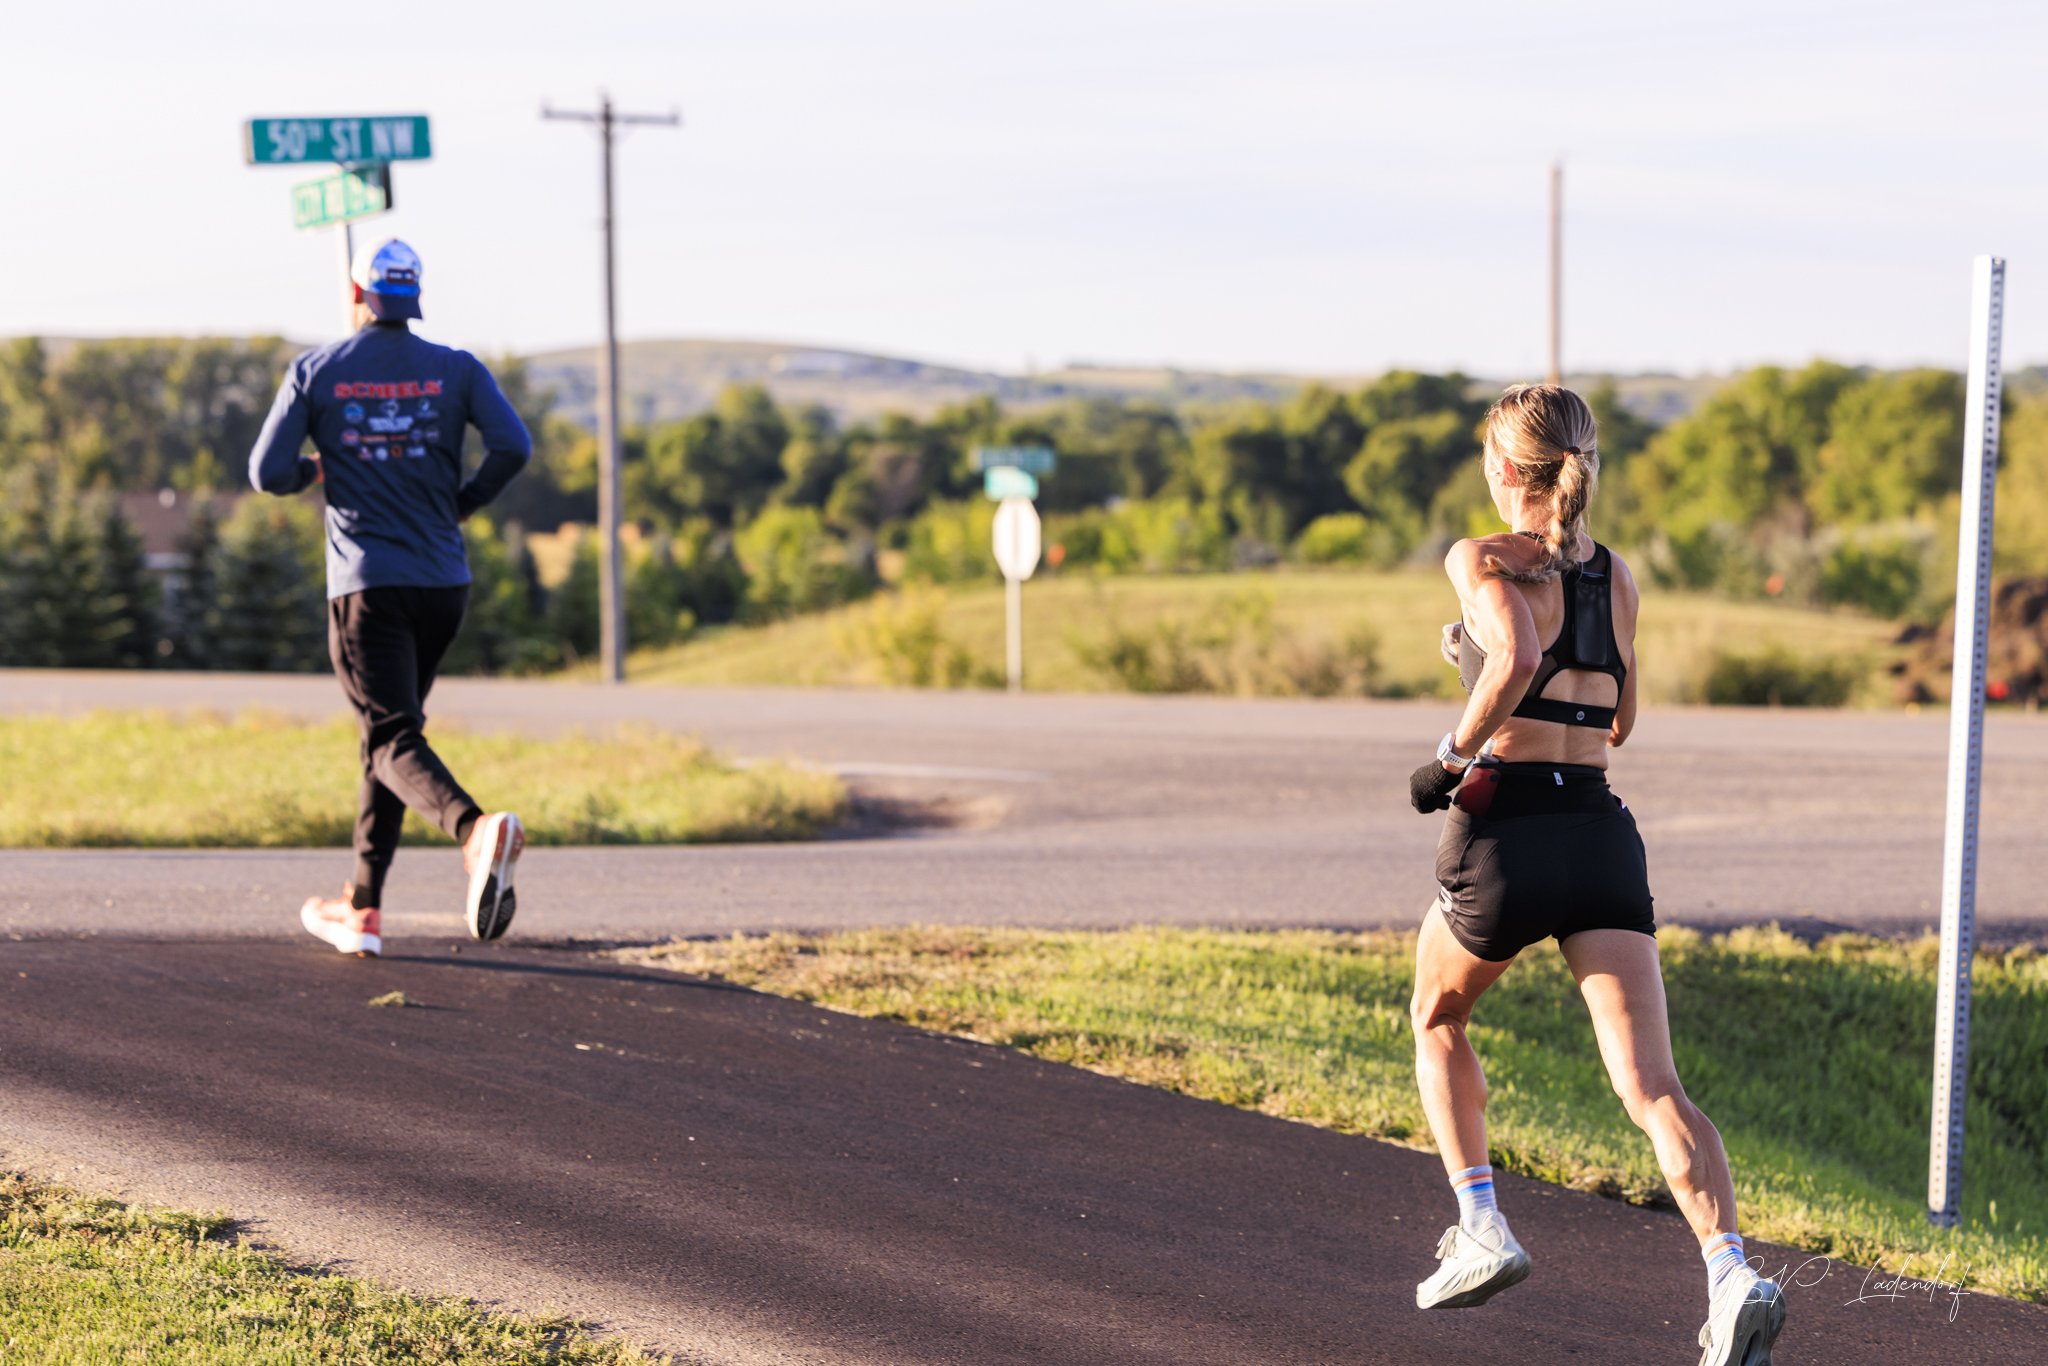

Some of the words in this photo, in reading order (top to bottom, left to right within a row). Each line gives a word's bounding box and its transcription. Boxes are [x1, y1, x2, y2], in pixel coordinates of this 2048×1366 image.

[329, 119, 362, 160] ST
[370, 118, 415, 157] NW
[334, 380, 441, 398] SCHEELS
